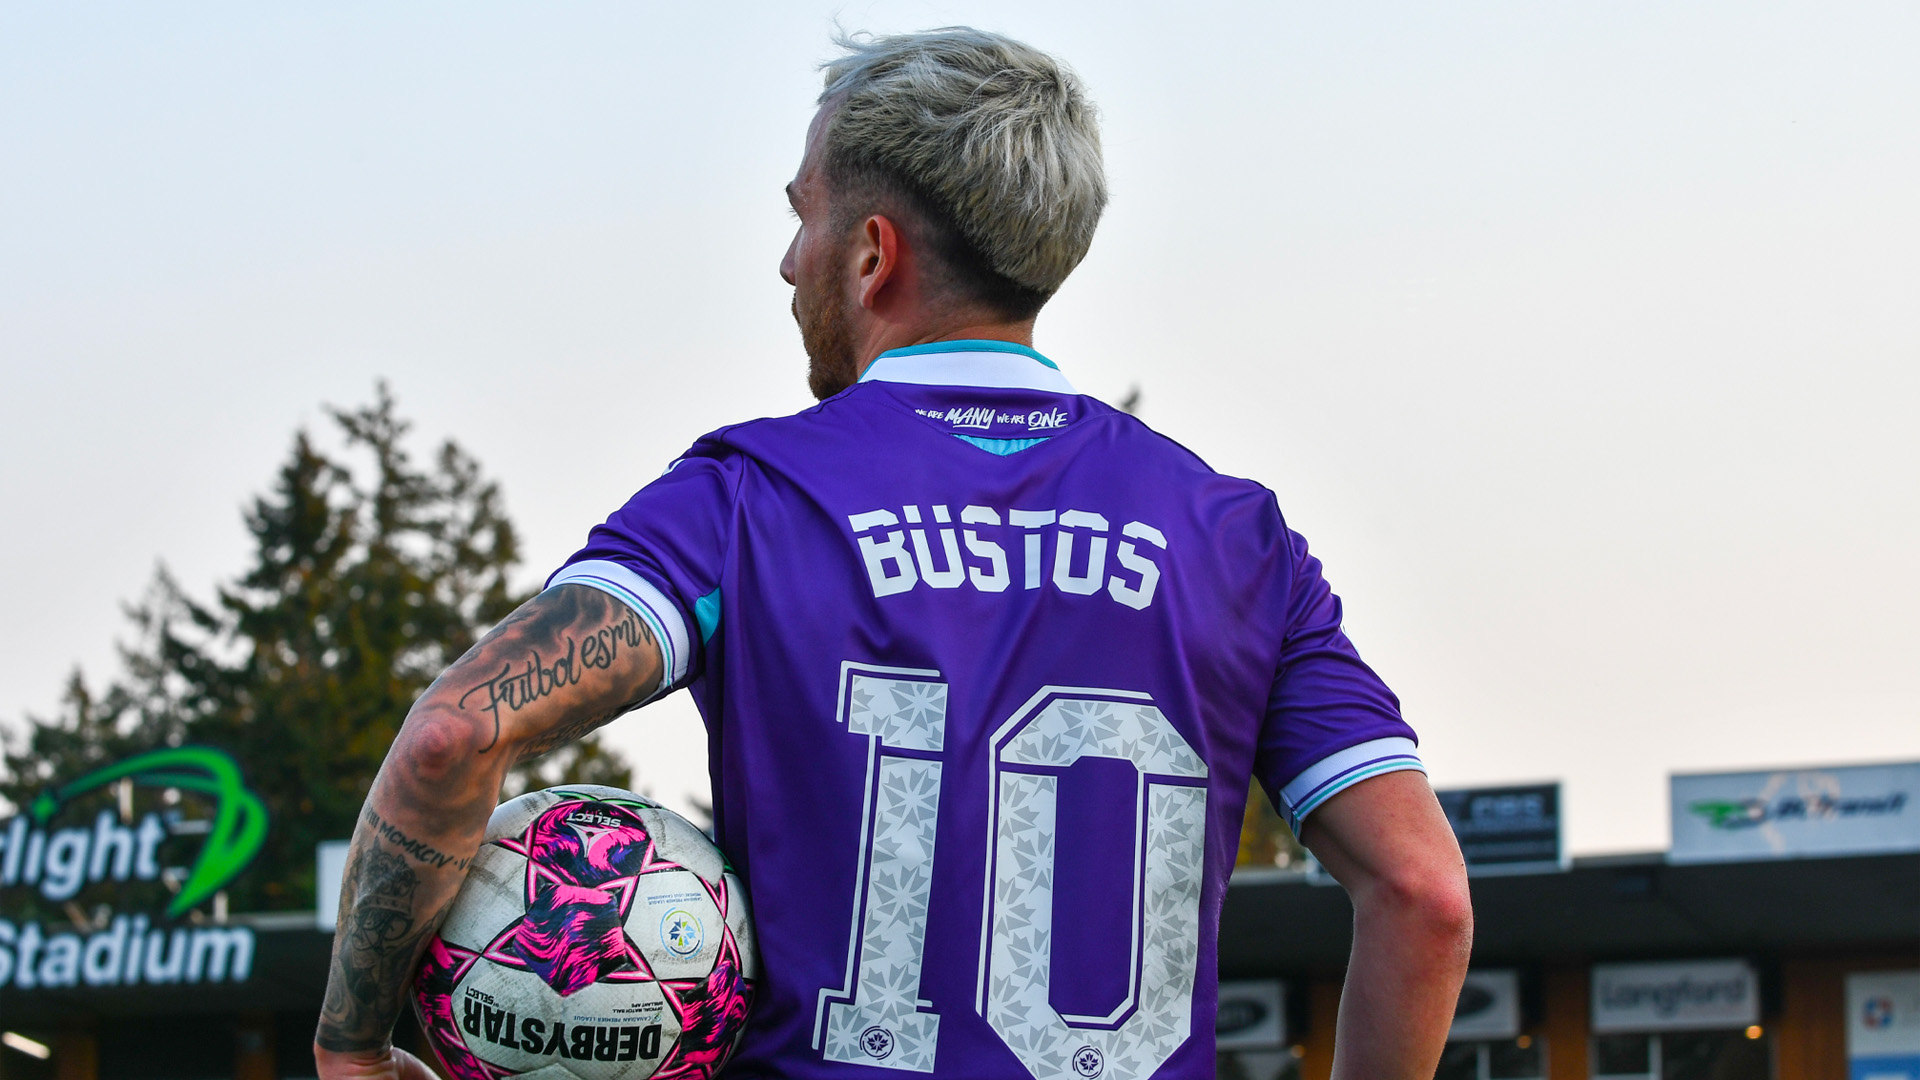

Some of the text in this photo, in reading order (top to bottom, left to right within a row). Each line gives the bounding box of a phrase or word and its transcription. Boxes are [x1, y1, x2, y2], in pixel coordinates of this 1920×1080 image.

[915, 407, 1068, 431] WE ARE MANY WE ARE ONE
[848, 504, 1168, 611] BUSTOS
[566, 812, 622, 828] SELECT
[0, 809, 164, 899] light
[811, 660, 1209, 1080] 10
[465, 986, 494, 1005] SELECT
[463, 996, 662, 1062] DERBYSTAR
